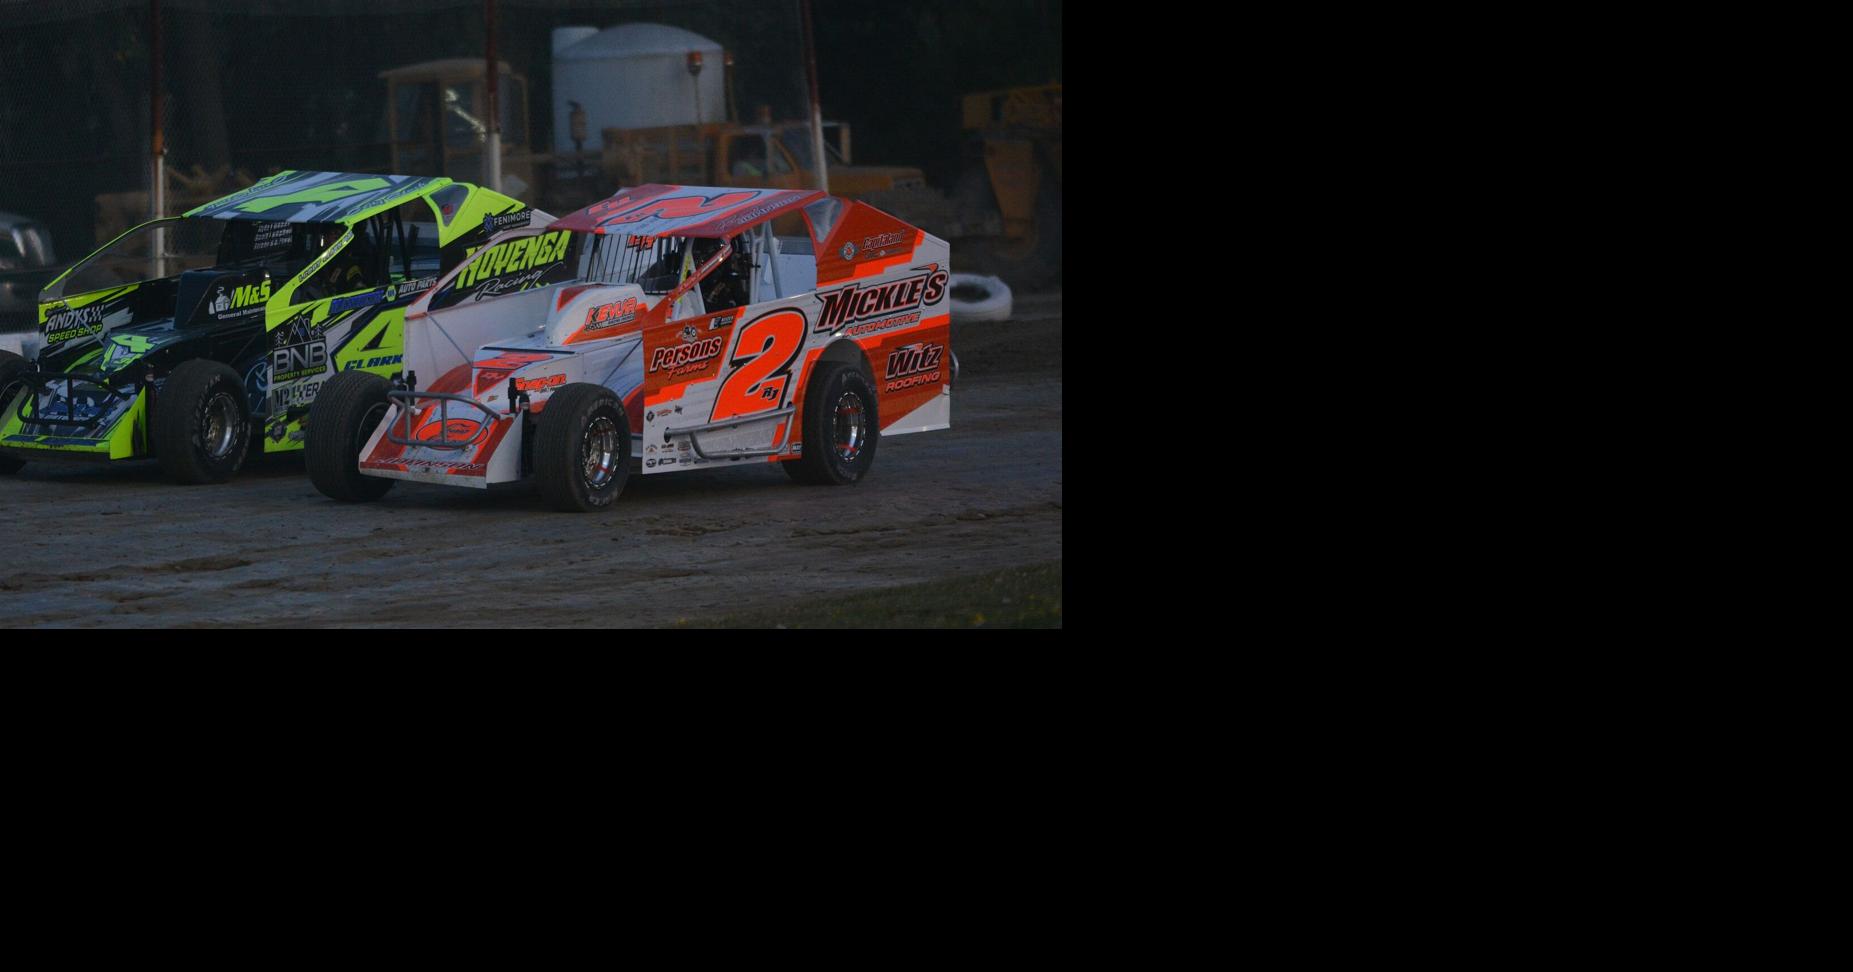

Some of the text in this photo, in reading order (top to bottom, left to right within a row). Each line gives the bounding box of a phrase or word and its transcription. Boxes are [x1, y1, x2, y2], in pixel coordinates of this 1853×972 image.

[493, 210, 531, 226] FENIMORE
[398, 283, 418, 294] AUTO
[475, 261, 565, 301] Racing
[230, 279, 272, 310] M&S
[47, 329, 76, 344] SPEED
[844, 312, 920, 337] AUTOMOTIVE
[273, 341, 328, 375] BNB
[649, 336, 723, 374] Persons
[707, 306, 809, 424] 2
[667, 362, 710, 381] Farms
[885, 371, 942, 393] ROOFING
